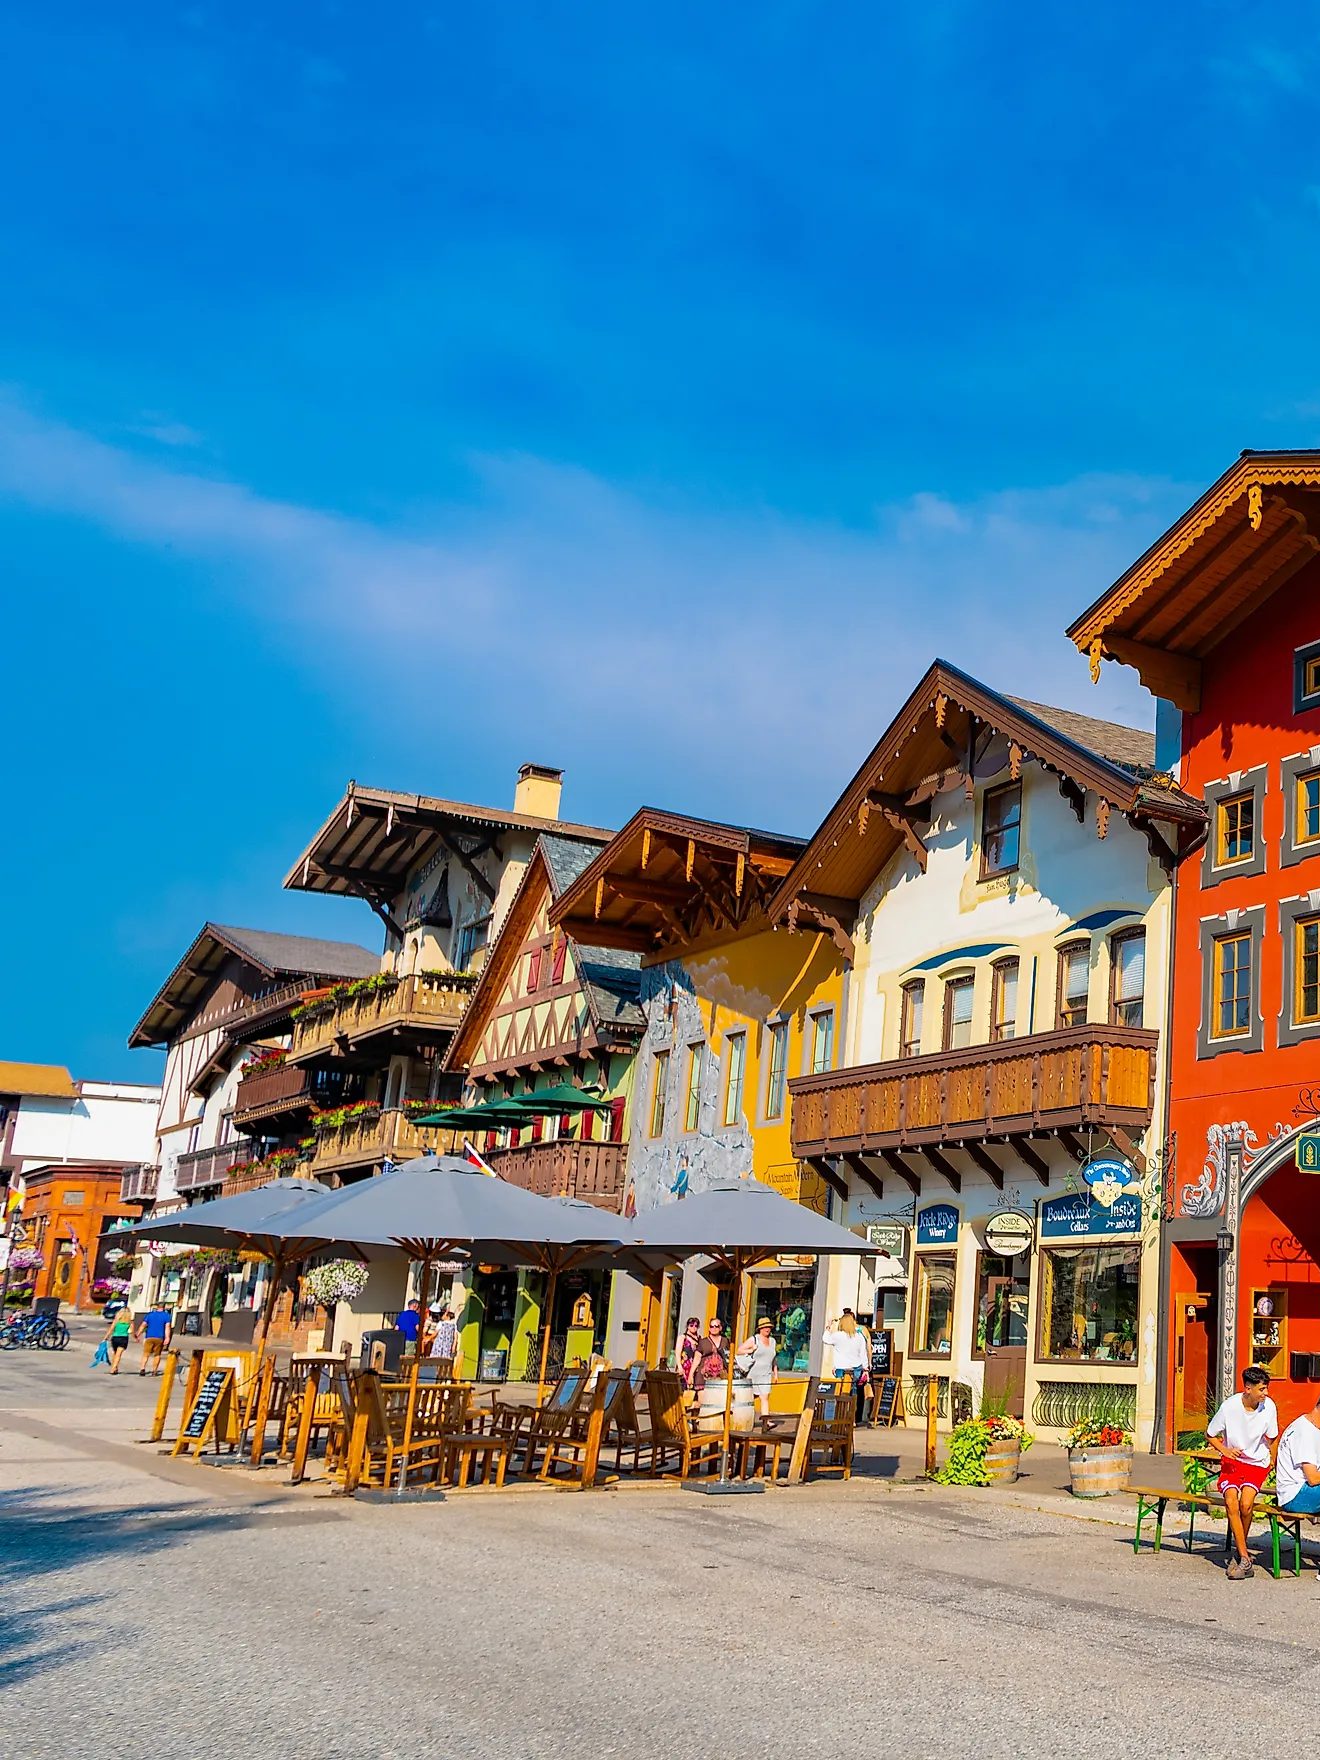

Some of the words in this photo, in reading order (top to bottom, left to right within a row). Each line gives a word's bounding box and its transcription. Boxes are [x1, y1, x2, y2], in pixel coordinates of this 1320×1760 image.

[1046, 1206, 1090, 1222] Boudreaux
[1110, 1200, 1137, 1217] Inside
[937, 1212, 957, 1229] Ridge
[998, 1217, 1020, 1226] INSIDE
[1070, 1221, 1090, 1232] Cellars
[928, 1228, 947, 1239] Winery
